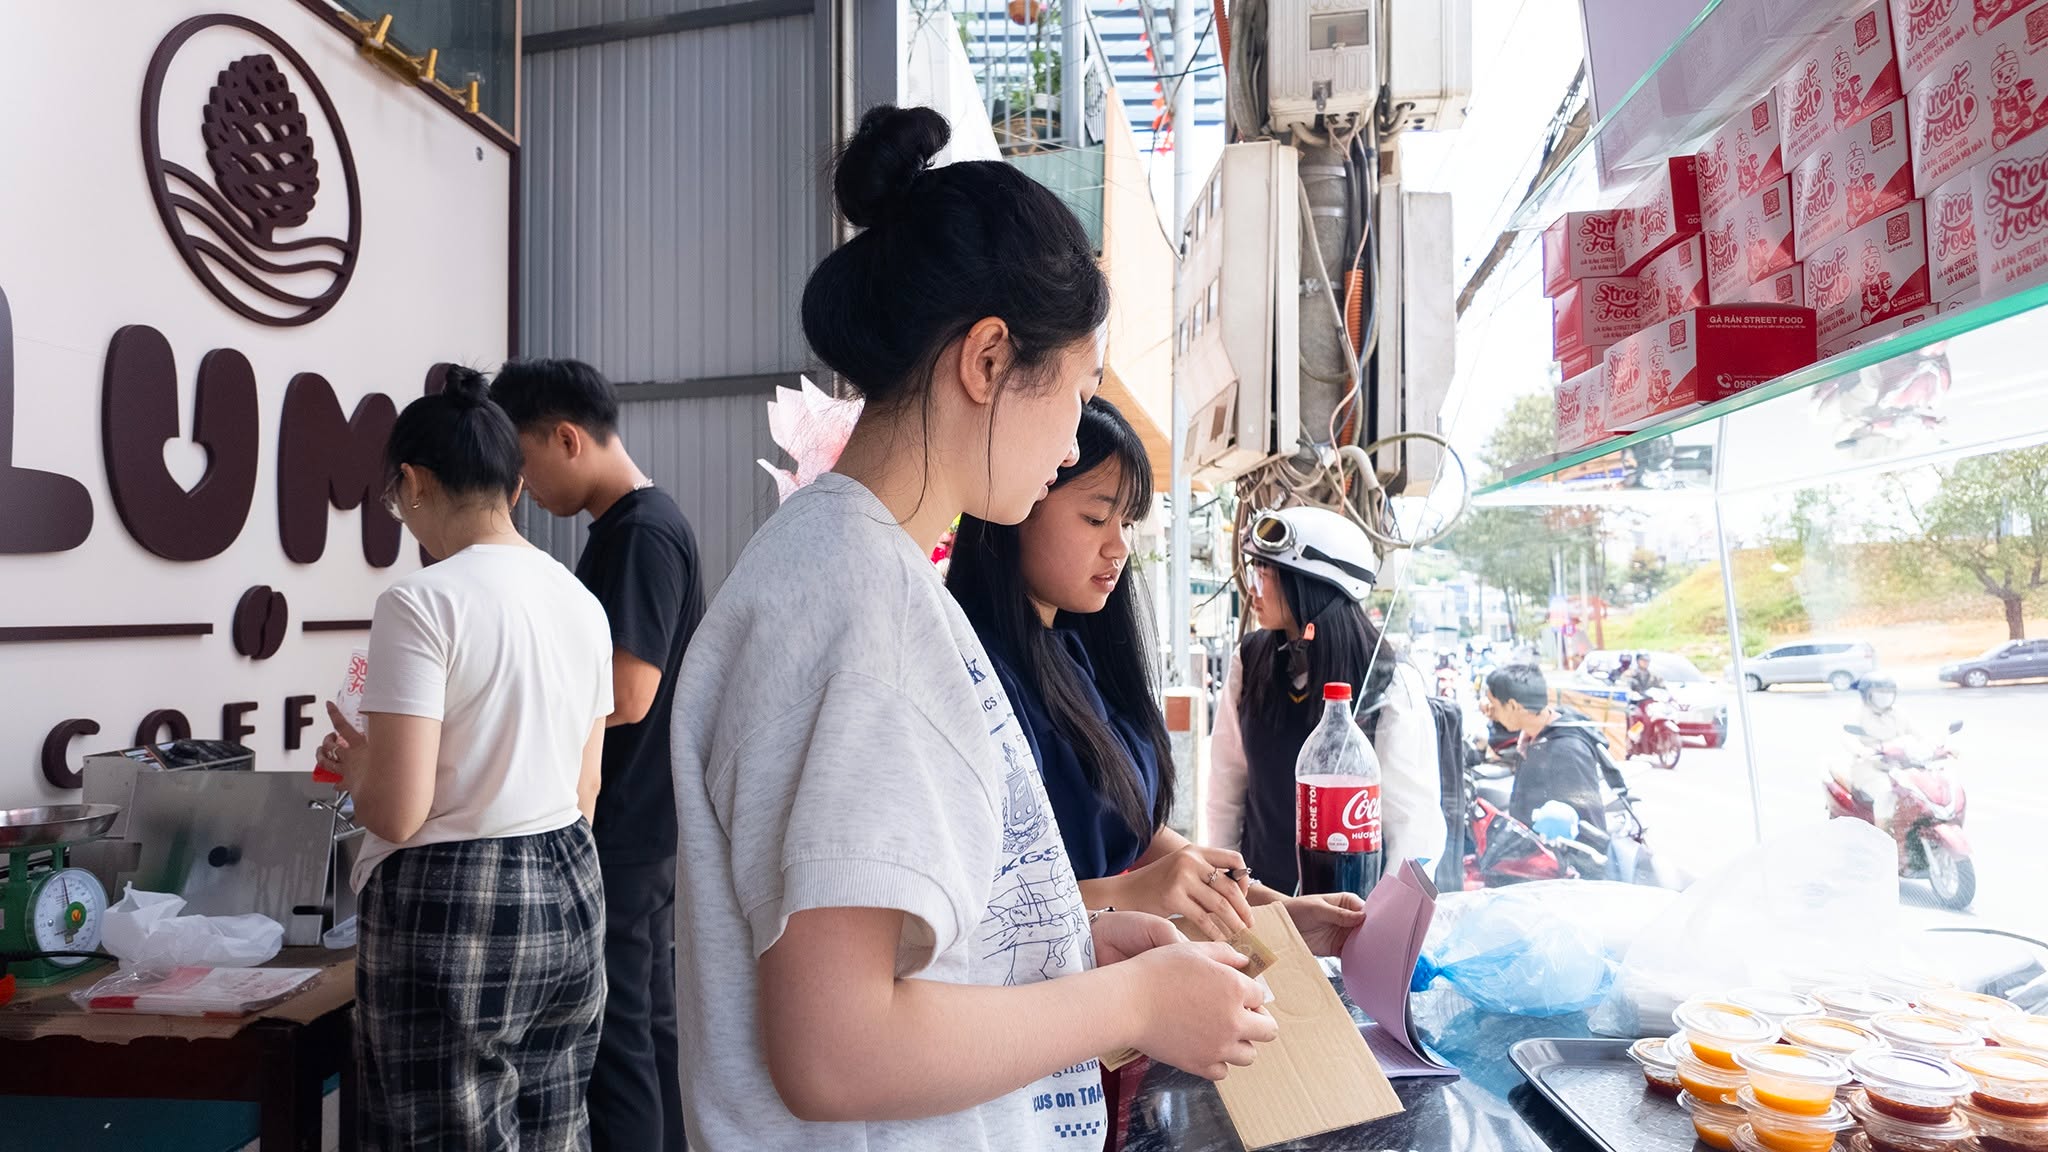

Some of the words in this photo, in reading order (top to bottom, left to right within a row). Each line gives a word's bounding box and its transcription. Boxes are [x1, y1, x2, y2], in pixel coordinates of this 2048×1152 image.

[1922, 99, 1965, 151] Food
[1809, 250, 1846, 291] Street
[1709, 315, 1722, 324] GÀ
[1724, 314, 1742, 324] RÁN
[1743, 316, 1777, 324] STREET
[1779, 316, 1803, 324] FOOD
